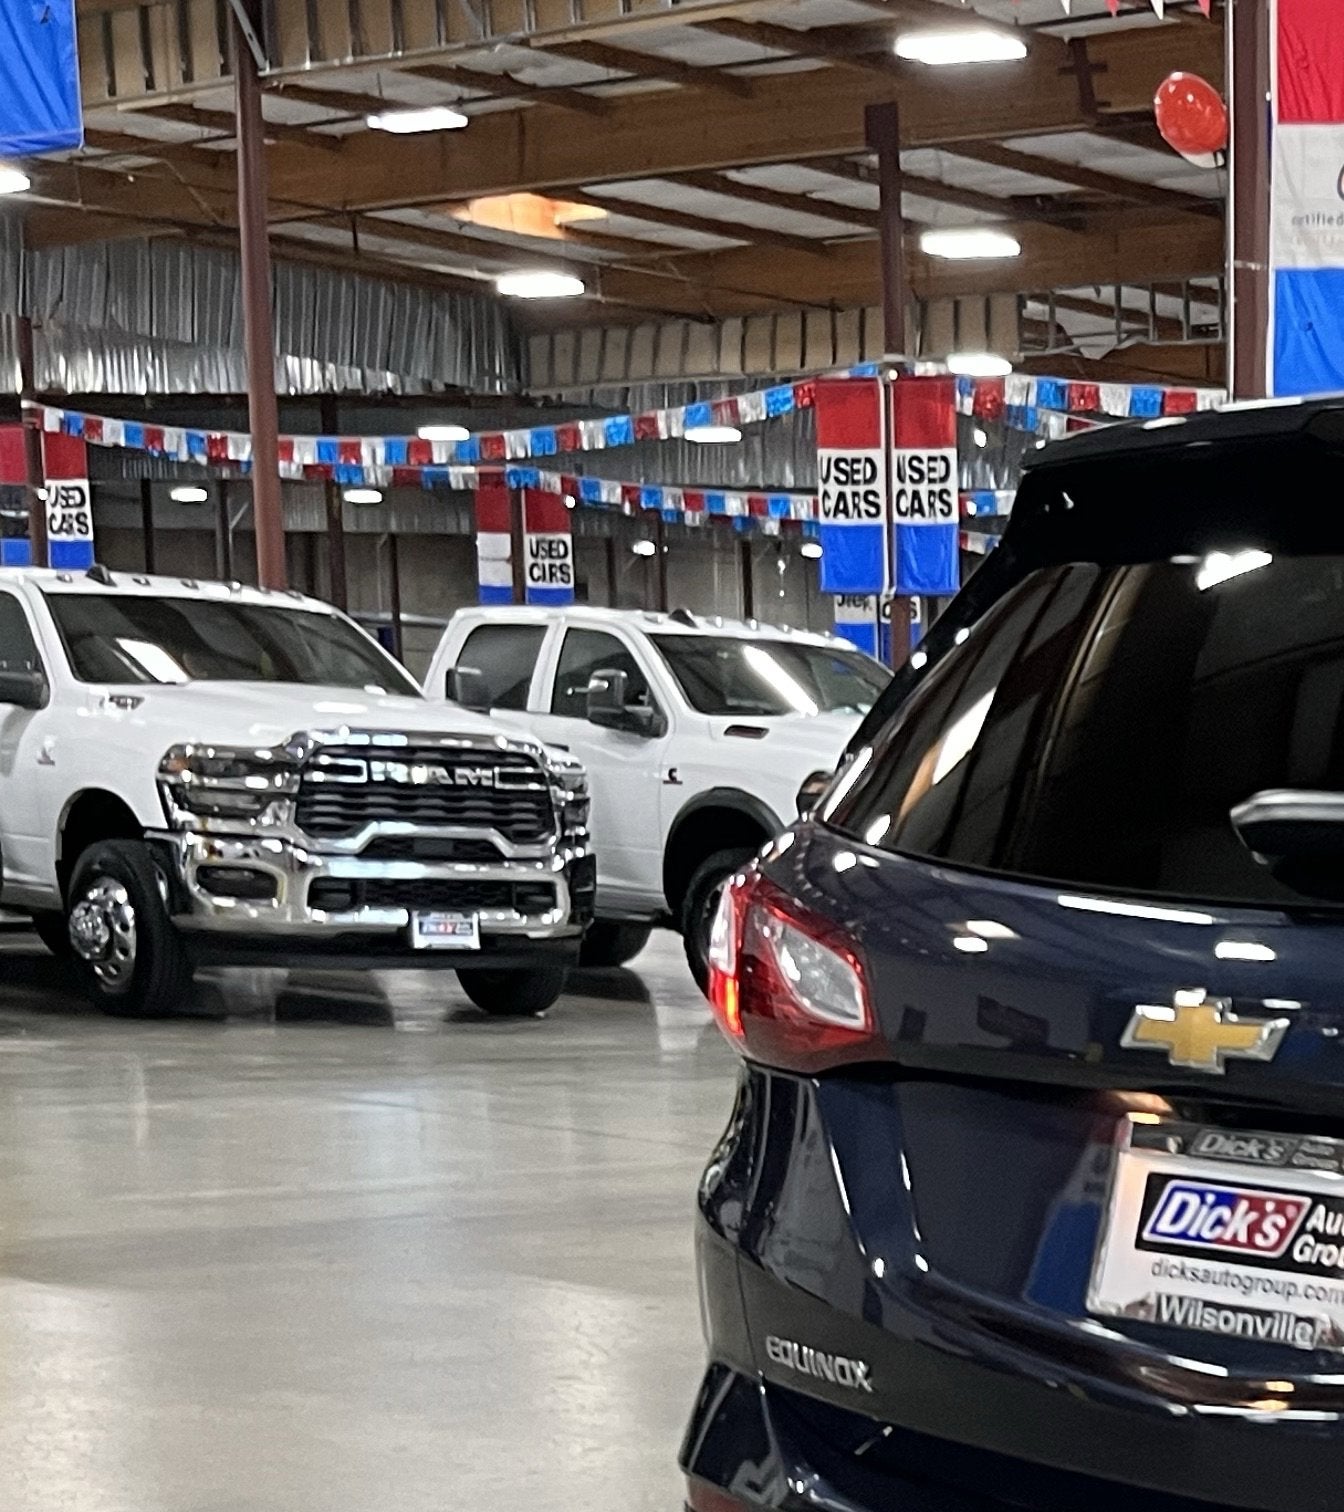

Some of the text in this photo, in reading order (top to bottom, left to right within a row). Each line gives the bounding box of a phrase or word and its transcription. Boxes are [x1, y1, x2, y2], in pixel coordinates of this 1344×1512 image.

[820, 456, 878, 486] USED
[896, 455, 951, 484] USED
[821, 489, 881, 518] CARS
[895, 488, 952, 519] CARS
[370, 760, 493, 785] RAM
[1155, 1190, 1287, 1248] Dick's
[1159, 1294, 1317, 1347] Wilsonville
[765, 1335, 873, 1393] EQUINOX
